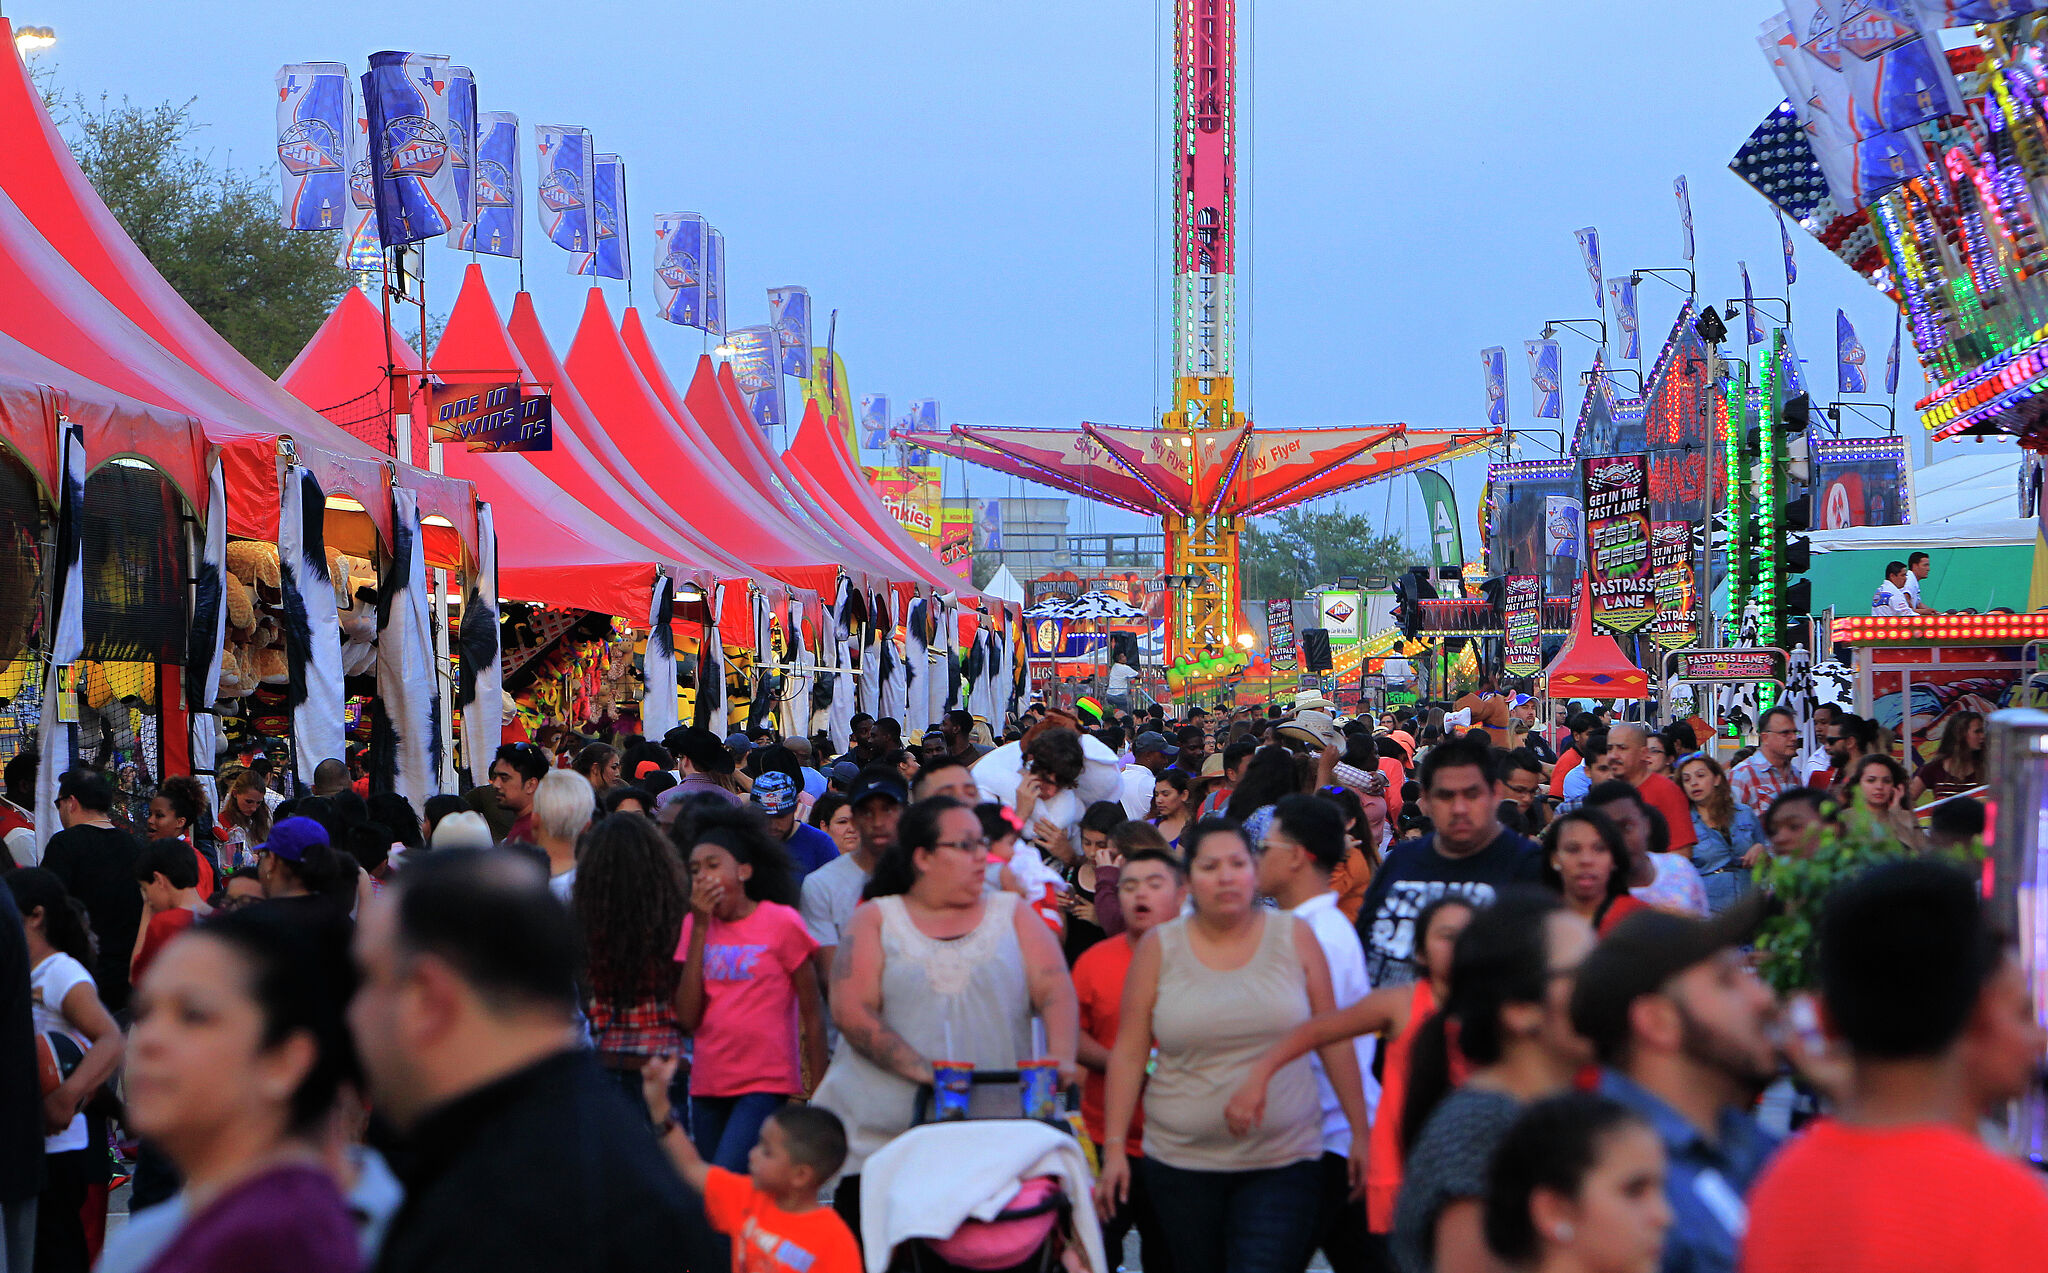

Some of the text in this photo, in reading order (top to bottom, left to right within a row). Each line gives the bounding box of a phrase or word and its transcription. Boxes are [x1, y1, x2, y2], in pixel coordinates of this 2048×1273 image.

[398, 144, 445, 168] RCS
[438, 386, 508, 421] ONE IN
[458, 408, 515, 439] WINS
[1150, 436, 1166, 460] Sky
[1166, 450, 1188, 472] Flye
[1246, 438, 1302, 474] Sky Flyer
[1589, 486, 1639, 507] GET IN THE
[882, 496, 932, 530] inkies
[1588, 505, 1613, 522] FAST
[1614, 501, 1641, 516] LANE
[1593, 520, 1641, 550] FAST
[1596, 541, 1648, 571] PASS
[1664, 546, 1672, 554] IN
[1673, 543, 1687, 553] THE
[1653, 557, 1666, 567] AST
[1668, 554, 1687, 564] LANE
[1654, 568, 1687, 588] FAST
[1590, 578, 1656, 597] FASTPASS
[1656, 584, 1692, 604] PASS
[1506, 592, 1536, 604] GET IN THE
[1506, 602, 1520, 612] FAST
[1520, 600, 1536, 610] LANE
[1602, 594, 1645, 610] LANE
[1508, 612, 1536, 628] FAST
[1656, 610, 1697, 622] ASTPASS
[1657, 622, 1690, 634] LANE
[1270, 648, 1296, 656] FASTPASS
[1505, 646, 1540, 656] FASTPASS
[1686, 654, 1766, 665] FASTPASS LANE
[1510, 656, 1536, 664] LANE
[1032, 666, 1052, 680] LEGS
